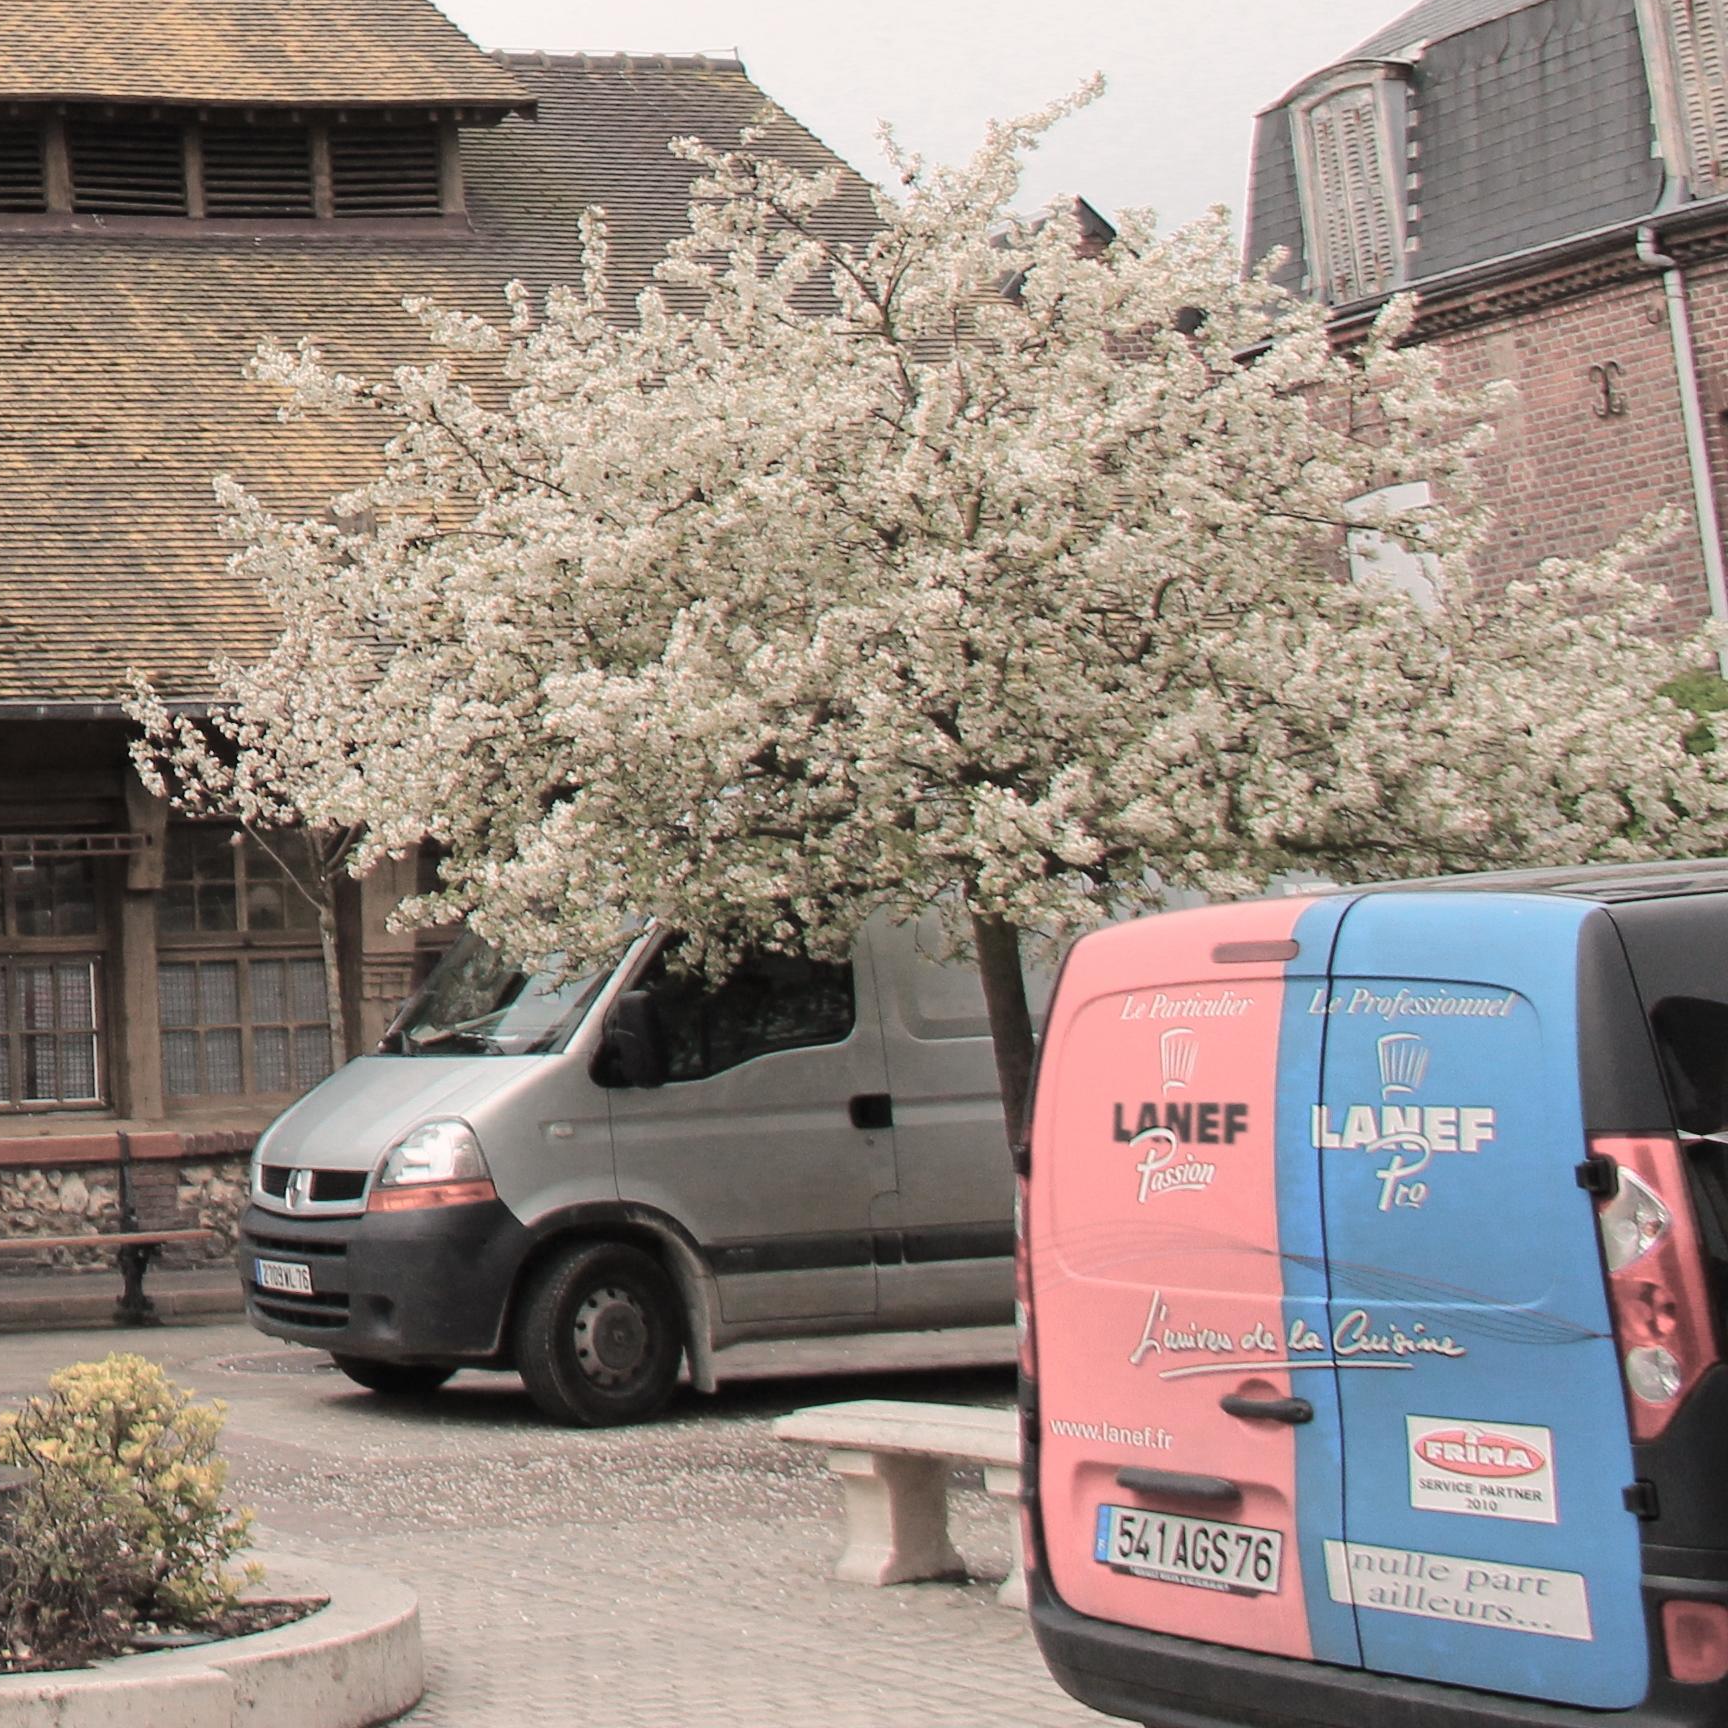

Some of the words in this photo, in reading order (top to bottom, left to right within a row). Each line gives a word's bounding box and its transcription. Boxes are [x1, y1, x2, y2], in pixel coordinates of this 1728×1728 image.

[1120, 994, 1146, 1020] Le
[1148, 991, 1255, 1020] Particulier
[1307, 988, 1342, 1014] Le
[1346, 988, 1519, 1022] Professionnel
[1113, 1102, 1249, 1145] LANEF
[1310, 1104, 1496, 1153] LANEF
[1129, 1126, 1216, 1203] Passion
[1366, 1132, 1430, 1211] Pro
[1239, 1322, 1276, 1352] de
[1287, 1319, 1324, 1352] la
[1333, 1309, 1468, 1358] Cuisine
[1049, 1418, 1174, 1450] www.lanef.fr
[1418, 1477, 1473, 1494] SERVICE
[1479, 1484, 1543, 1502] PARTNER
[1465, 1498, 1498, 1511] 2010
[1351, 1550, 1450, 1581] nulle
[1464, 1568, 1552, 1597] part
[1368, 1581, 1553, 1630] ailleurs...
